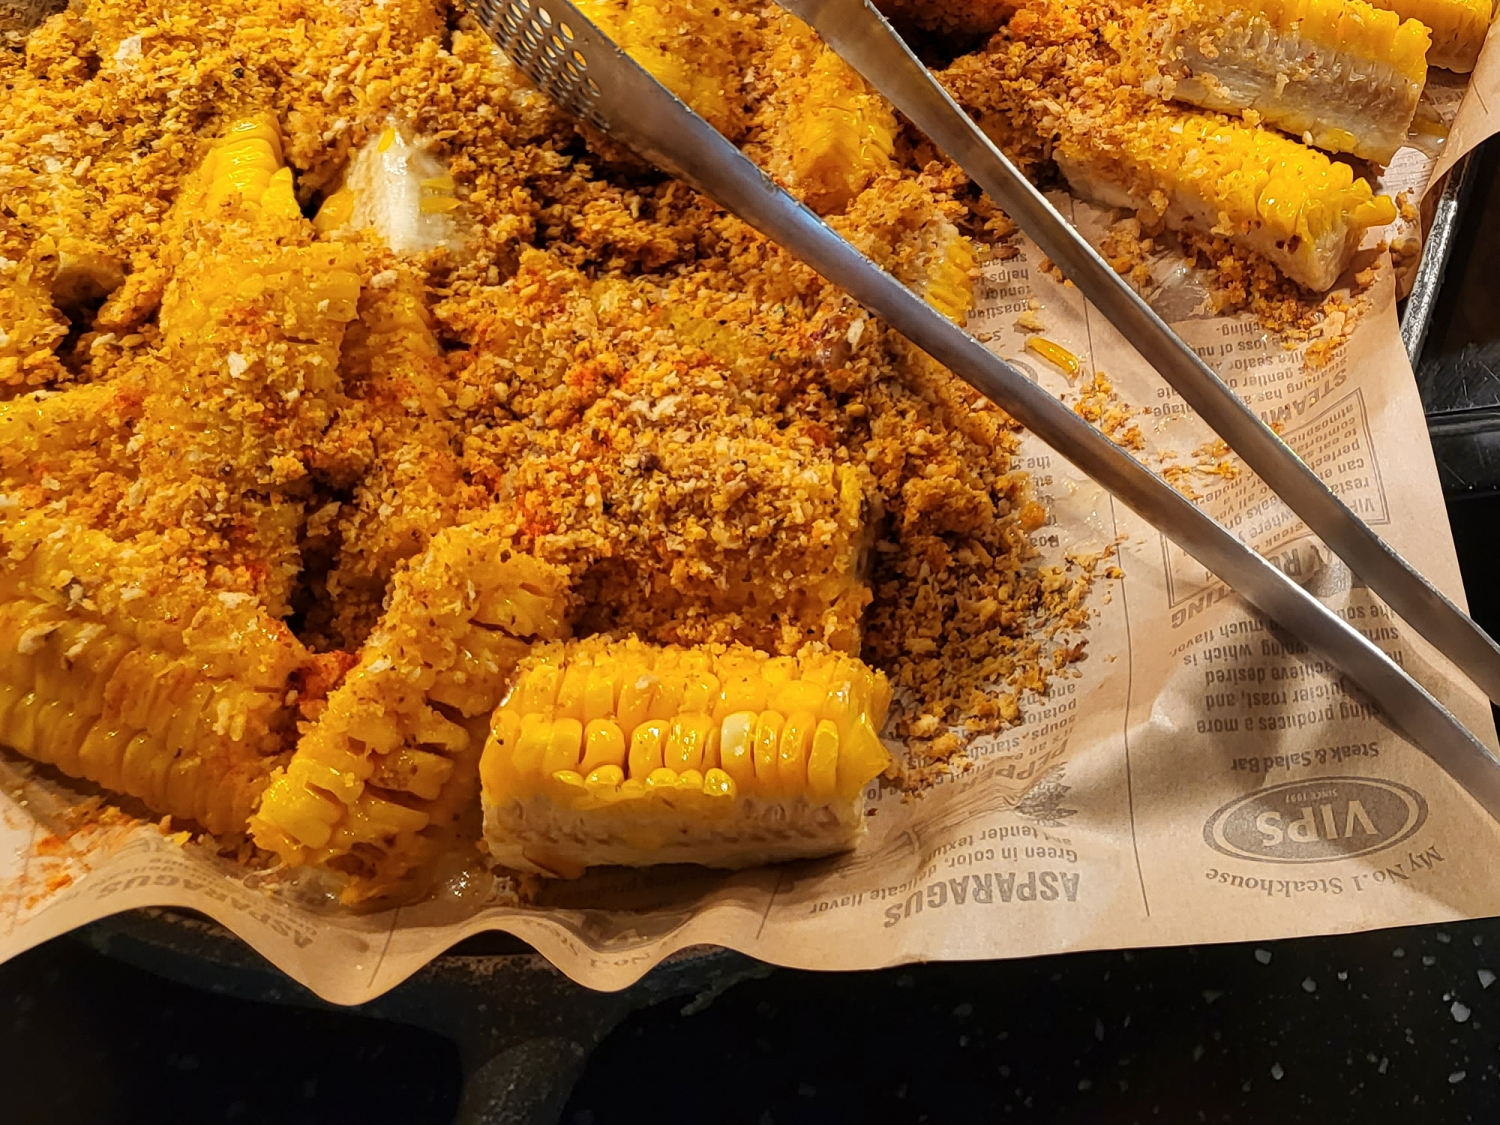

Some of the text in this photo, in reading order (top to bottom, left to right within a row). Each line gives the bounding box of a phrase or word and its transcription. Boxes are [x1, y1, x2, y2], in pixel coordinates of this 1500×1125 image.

[1241, 367, 1294, 392] gentler
[1336, 457, 1365, 475] can
[1203, 643, 1250, 661] which
[1205, 667, 1264, 685] desired
[1205, 693, 1234, 710] and
[1196, 704, 1332, 734] produces more
[1229, 741, 1379, 774] Steak Salad Bar
[1254, 798, 1381, 846] VIPS
[978, 824, 1038, 841] tender
[1001, 847, 1017, 862] in
[1025, 844, 1077, 864] Green
[1204, 844, 1444, 900] My No.1 Steakhouse
[881, 869, 1081, 927] ASPARAGUS
